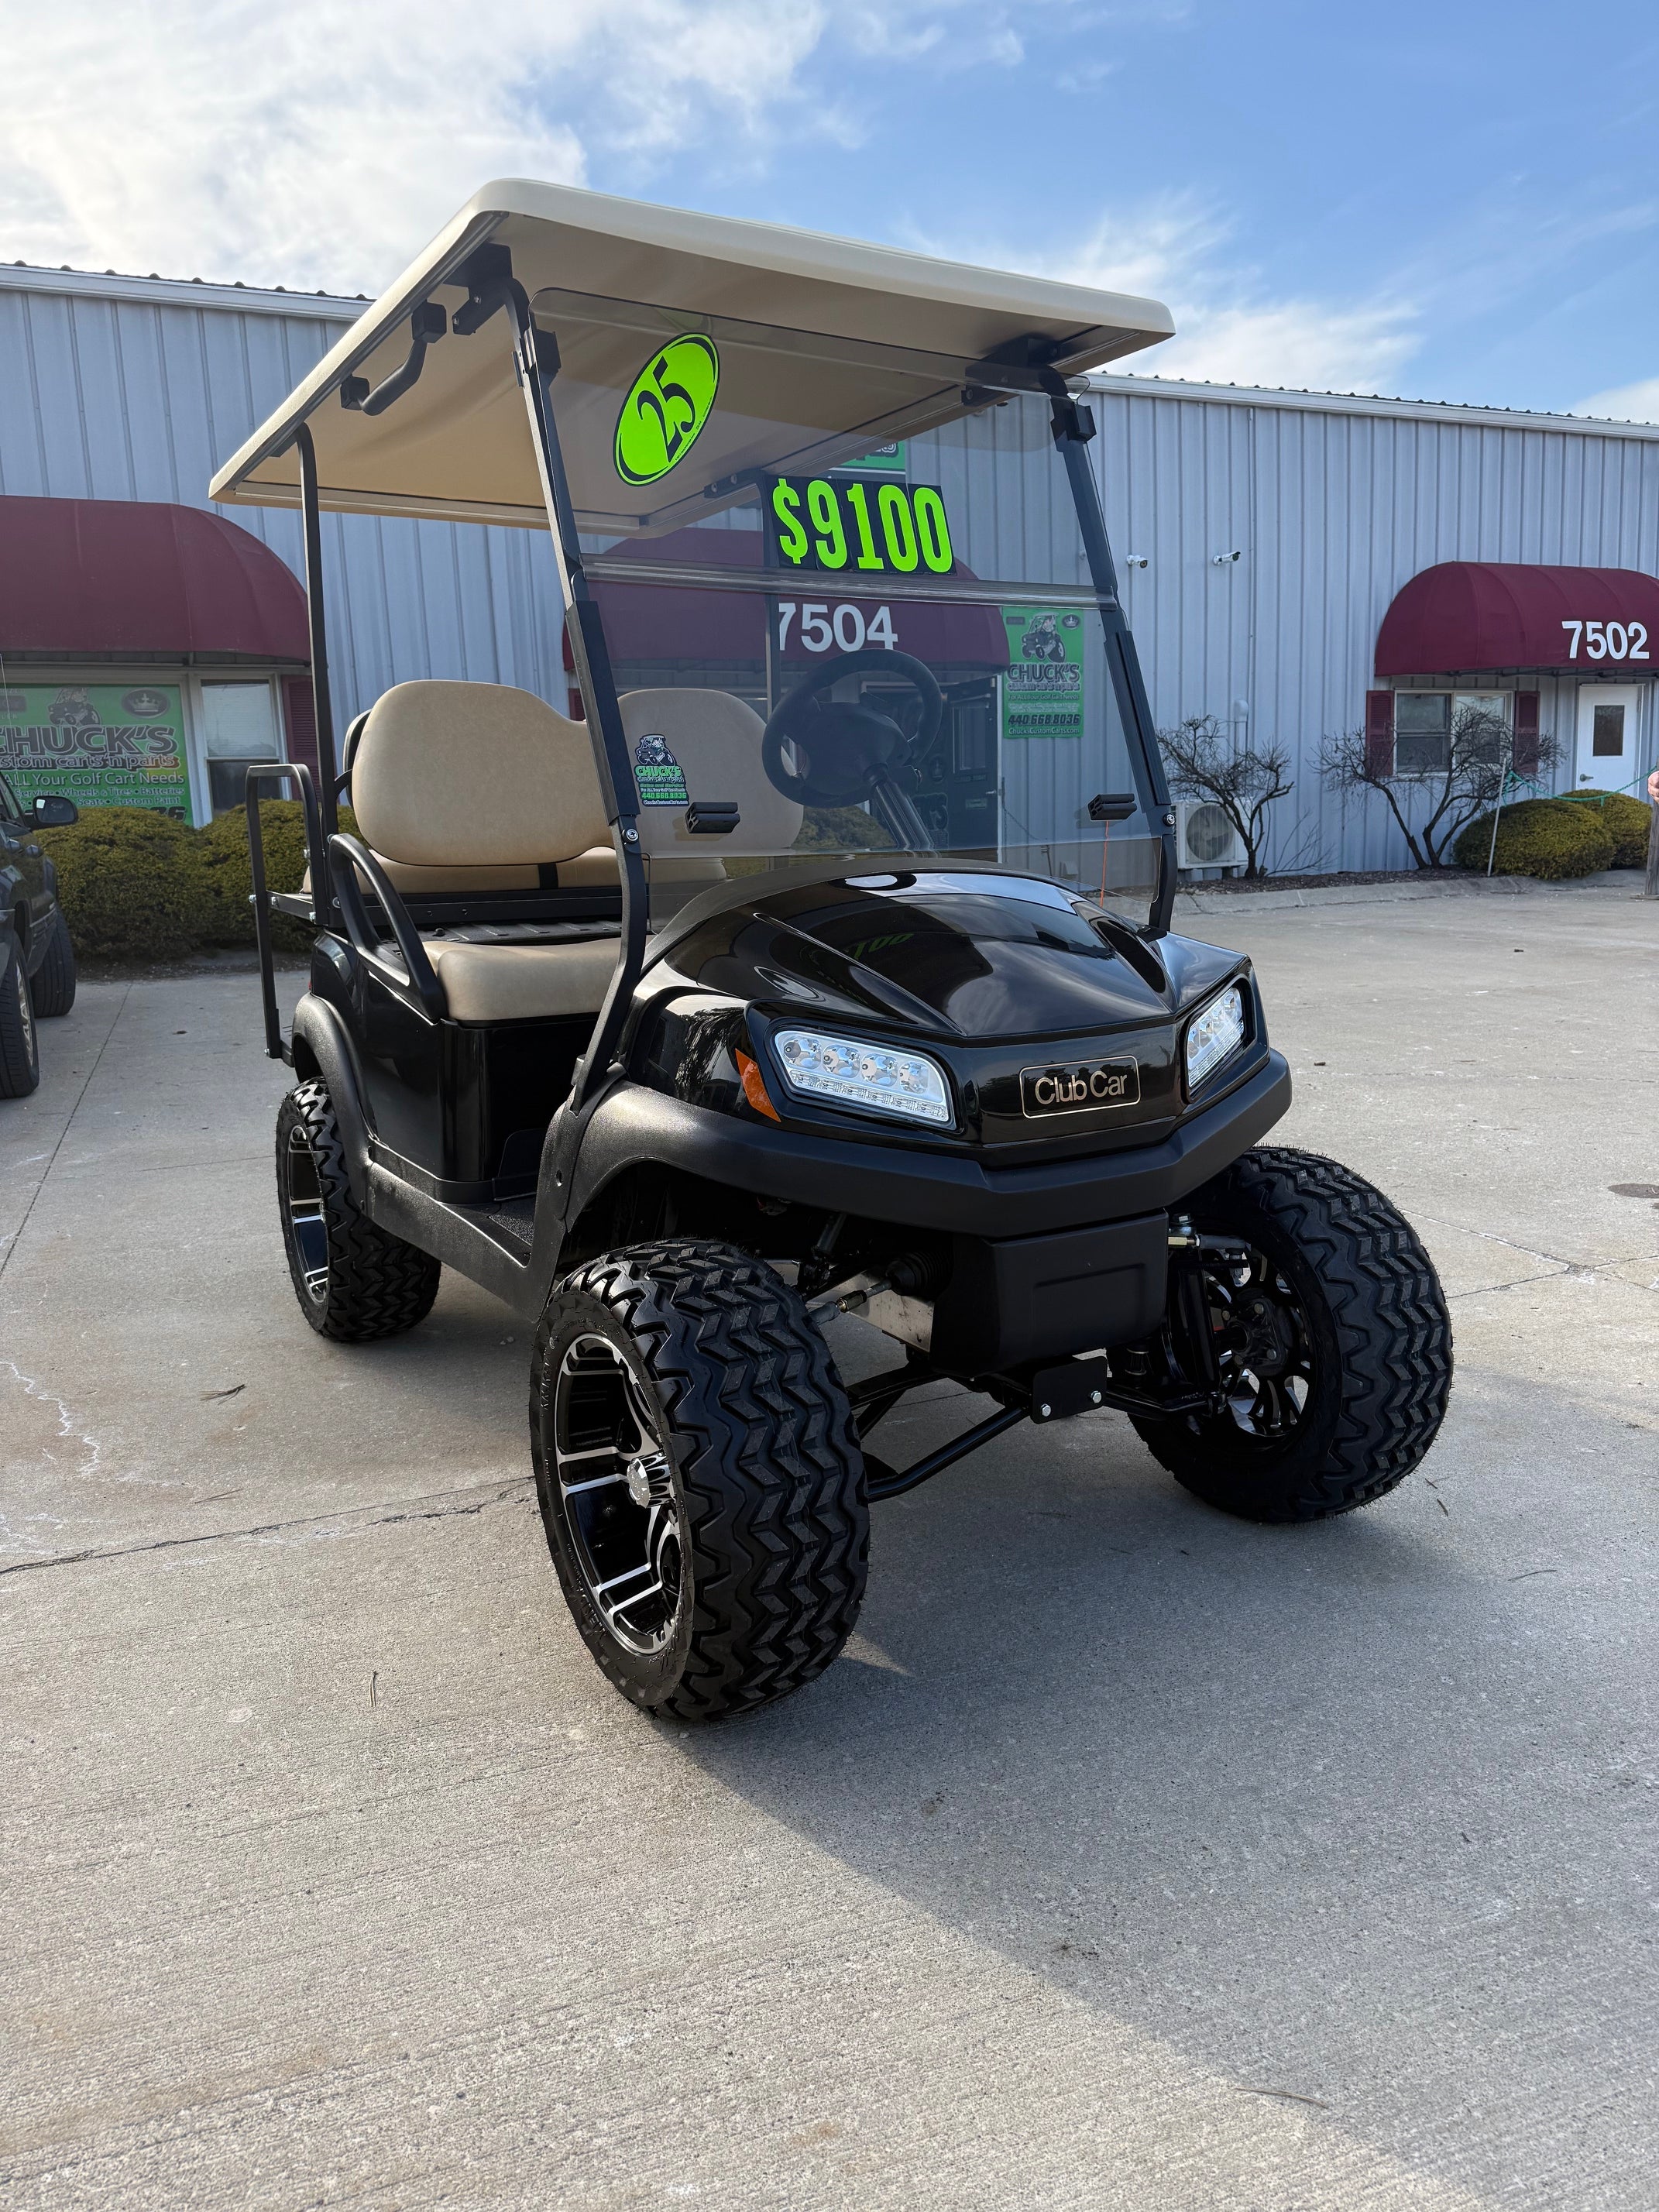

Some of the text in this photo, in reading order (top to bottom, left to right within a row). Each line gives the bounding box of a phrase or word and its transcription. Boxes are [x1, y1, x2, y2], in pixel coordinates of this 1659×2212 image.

[637, 356, 696, 463] 25
[772, 478, 953, 573] $9100
[778, 603, 898, 652] 7504
[1561, 620, 1650, 659] 7502
[1008, 662, 1080, 682] CHUCK'S
[1008, 714, 1080, 726] 440.668.8036
[0, 755, 51, 768] stom
[56, 755, 105, 768] carts
[126, 754, 175, 769] parts
[32, 774, 67, 785] Your
[70, 772, 101, 785] Golf
[105, 772, 135, 785] Cart
[139, 772, 184, 784] Needs
[635, 766, 682, 777] CHUCK'S
[61, 788, 98, 797] Wheels
[108, 787, 132, 795] Tires
[140, 787, 184, 795] Batteries
[112, 797, 152, 805] Custom
[155, 796, 180, 805] Paint
[1035, 1070, 1128, 1104] Club Car
